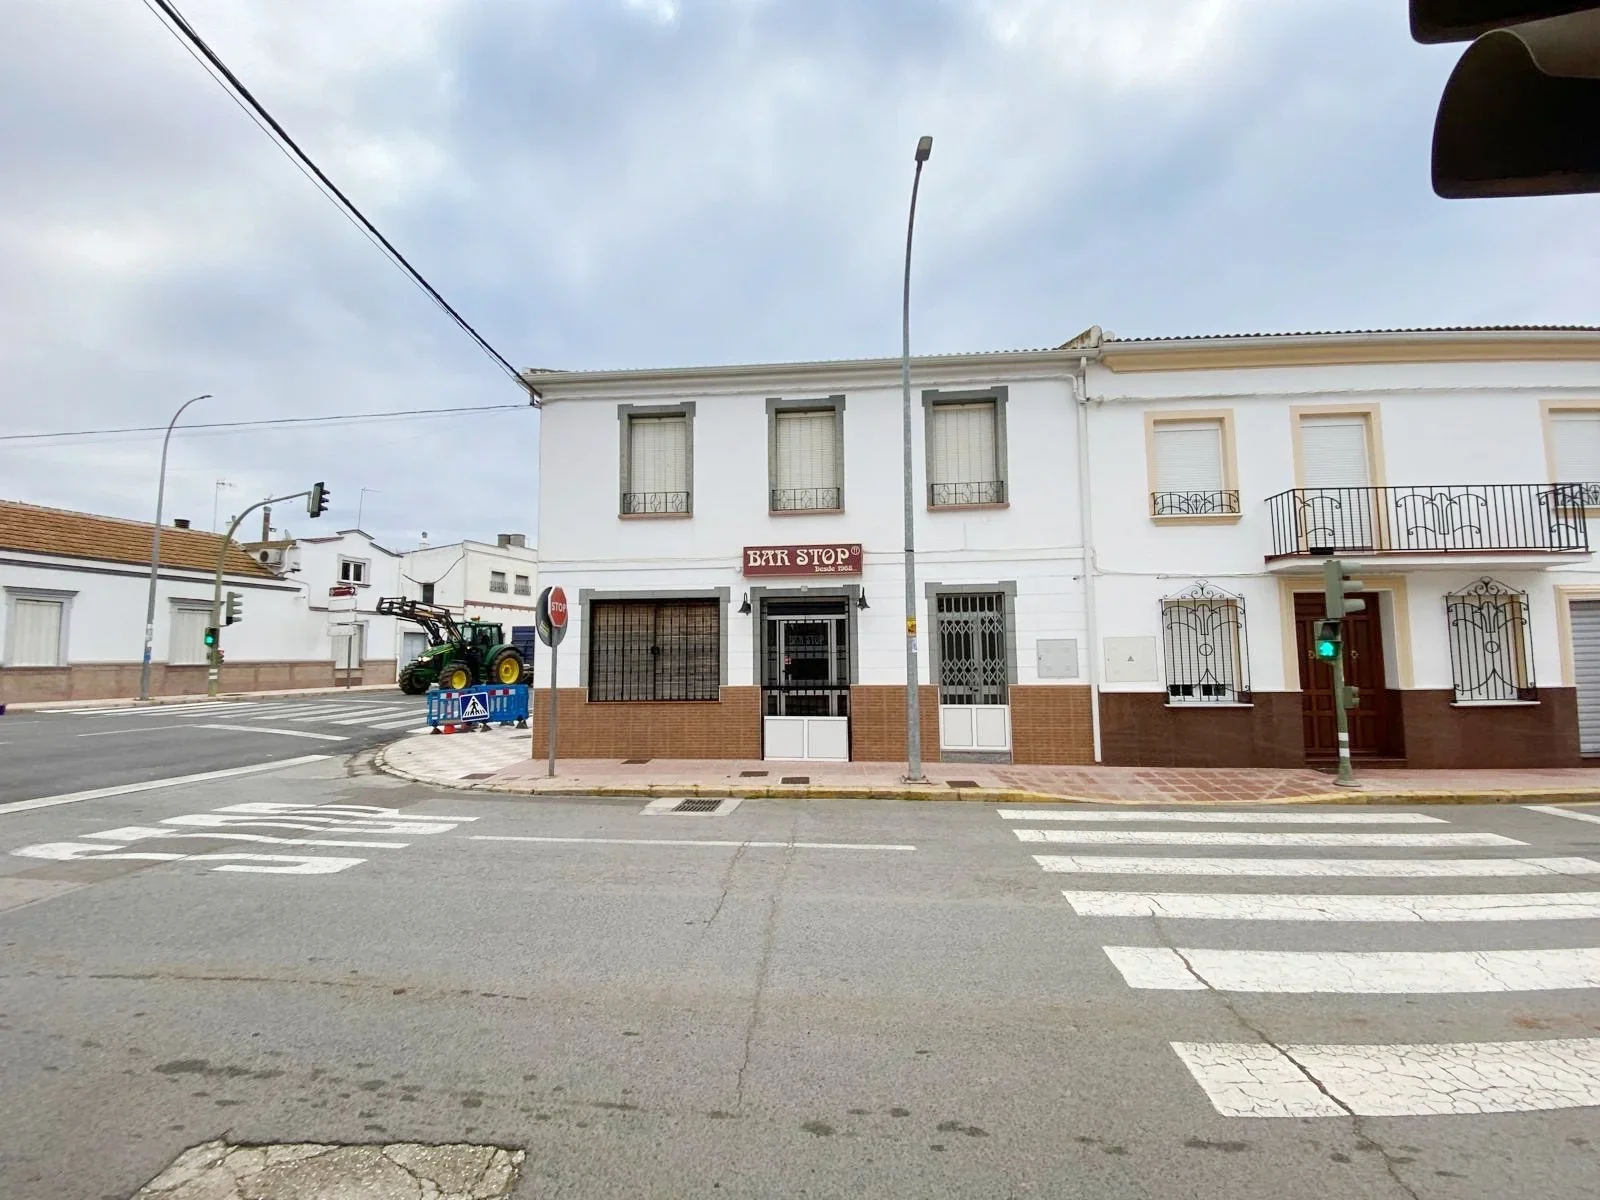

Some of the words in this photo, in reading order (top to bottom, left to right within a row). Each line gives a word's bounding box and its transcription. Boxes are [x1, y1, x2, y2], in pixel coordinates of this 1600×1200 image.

[747, 550, 790, 566] BAR
[796, 548, 849, 565] STOP
[551, 601, 566, 612] STOP
